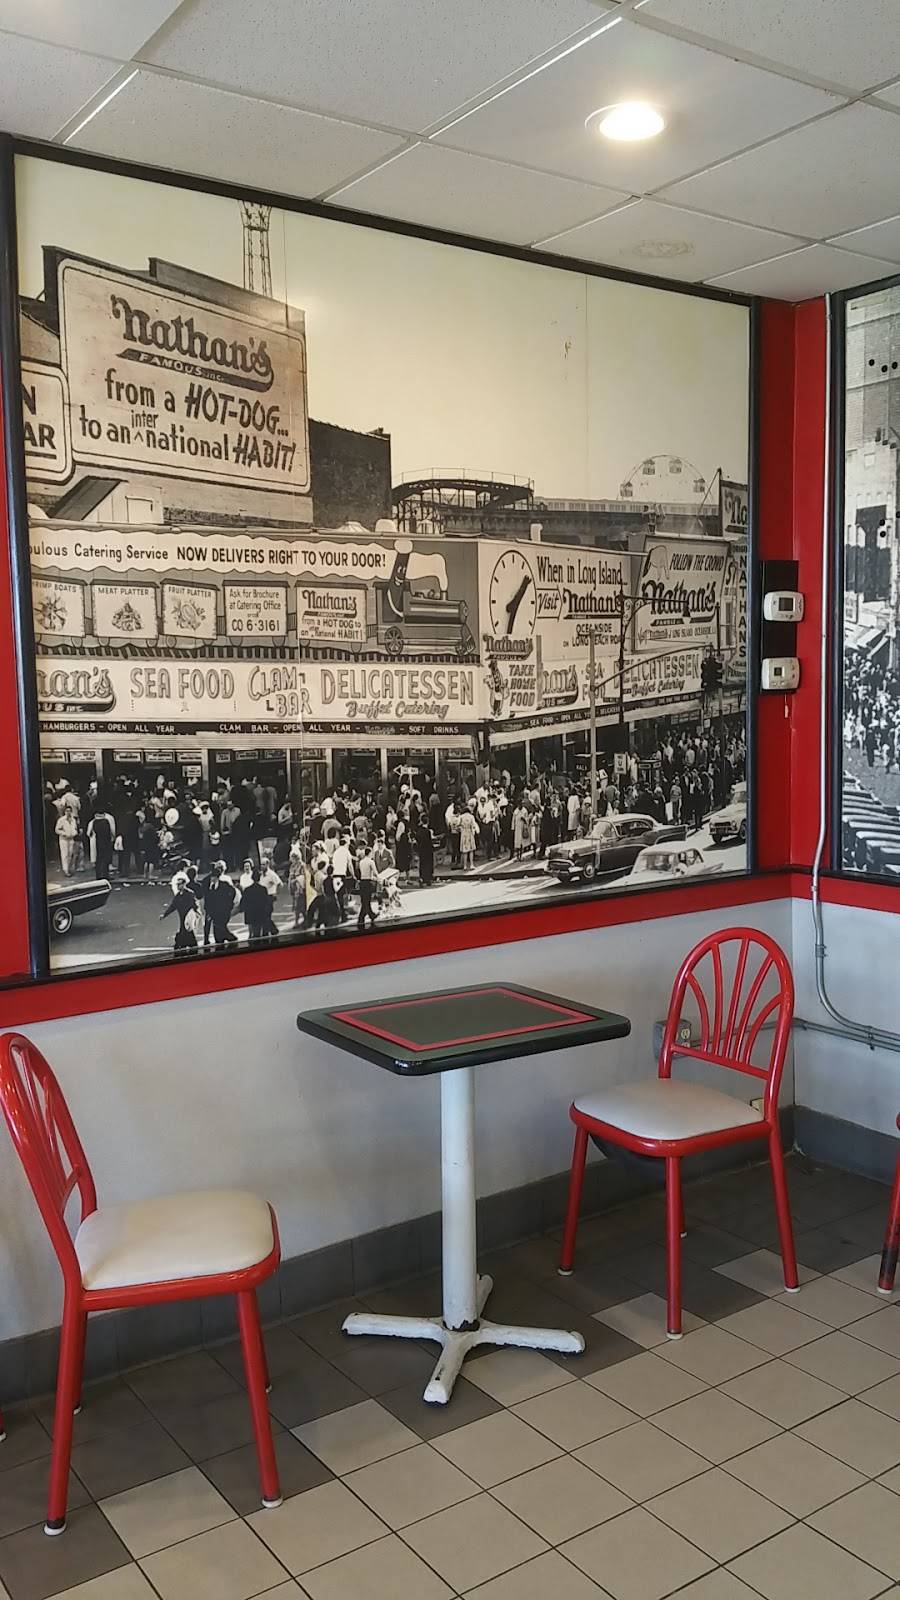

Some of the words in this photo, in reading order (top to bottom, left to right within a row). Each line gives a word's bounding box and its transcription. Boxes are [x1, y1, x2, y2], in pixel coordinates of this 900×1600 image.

[111, 293, 274, 377] Nathan's
[140, 352, 203, 383] FAMOUS
[105, 368, 155, 409] from
[165, 390, 176, 413] a
[131, 410, 159, 428] inter
[80, 404, 102, 440] to
[106, 423, 131, 444] an
[146, 423, 229, 462] national
[233, 432, 298, 474] HABIT!
[74, 543, 122, 563] Catering
[126, 544, 168, 560] Service
[177, 546, 208, 563] NOW
[212, 547, 265, 564] DELIVERS
[268, 550, 299, 565] RIGHT
[302, 551, 317, 566] TO
[317, 551, 348, 568] YOUR
[351, 553, 386, 568] DOOR!
[669, 553, 694, 571] FOLLOW
[693, 555, 706, 571] THE
[705, 555, 724, 571] CROWD
[537, 556, 563, 583] When
[567, 558, 575, 583] in
[578, 559, 597, 591] Long
[54, 583, 77, 593] BOATS
[98, 587, 119, 595] MEAT
[120, 588, 149, 596] PLATTER
[168, 586, 185, 595] FRUIT
[186, 588, 211, 598] PLATTER
[229, 588, 241, 598] Ask
[242, 588, 252, 598] for
[253, 589, 279, 599] Brochure
[642, 579, 716, 615] Nathan's
[229, 602, 236, 610] at
[236, 601, 261, 612] Catering
[263, 601, 281, 610] Office
[302, 589, 357, 611] Nathan's
[538, 593, 559, 614] Visit
[231, 619, 243, 632] CO
[323, 619, 337, 627] HOT
[338, 620, 353, 628] DOG
[572, 635, 589, 647] LONG
[509, 664, 535, 677] TAKE
[130, 667, 171, 699] SEA
[178, 667, 235, 699] FOOD
[248, 665, 298, 702] CLAM
[320, 668, 474, 706] DELICATESSEN
[510, 677, 537, 690] HOME
[276, 688, 313, 718] BAR
[509, 692, 536, 707] FOOD
[345, 700, 394, 719] Buffet
[395, 701, 450, 720] Catering
[43, 722, 96, 731] HAMBURGERS
[107, 723, 127, 732] OPEN
[134, 724, 149, 732] ALL
[156, 724, 175, 733] YEAR
[219, 723, 242, 732] CLAM
[251, 724, 269, 732] BAR
[282, 724, 302, 733] OPEN
[309, 724, 323, 733] ALL
[331, 724, 352, 733] YEAR
[433, 726, 459, 734] DRINKS
[529, 719, 540, 727] SEA
